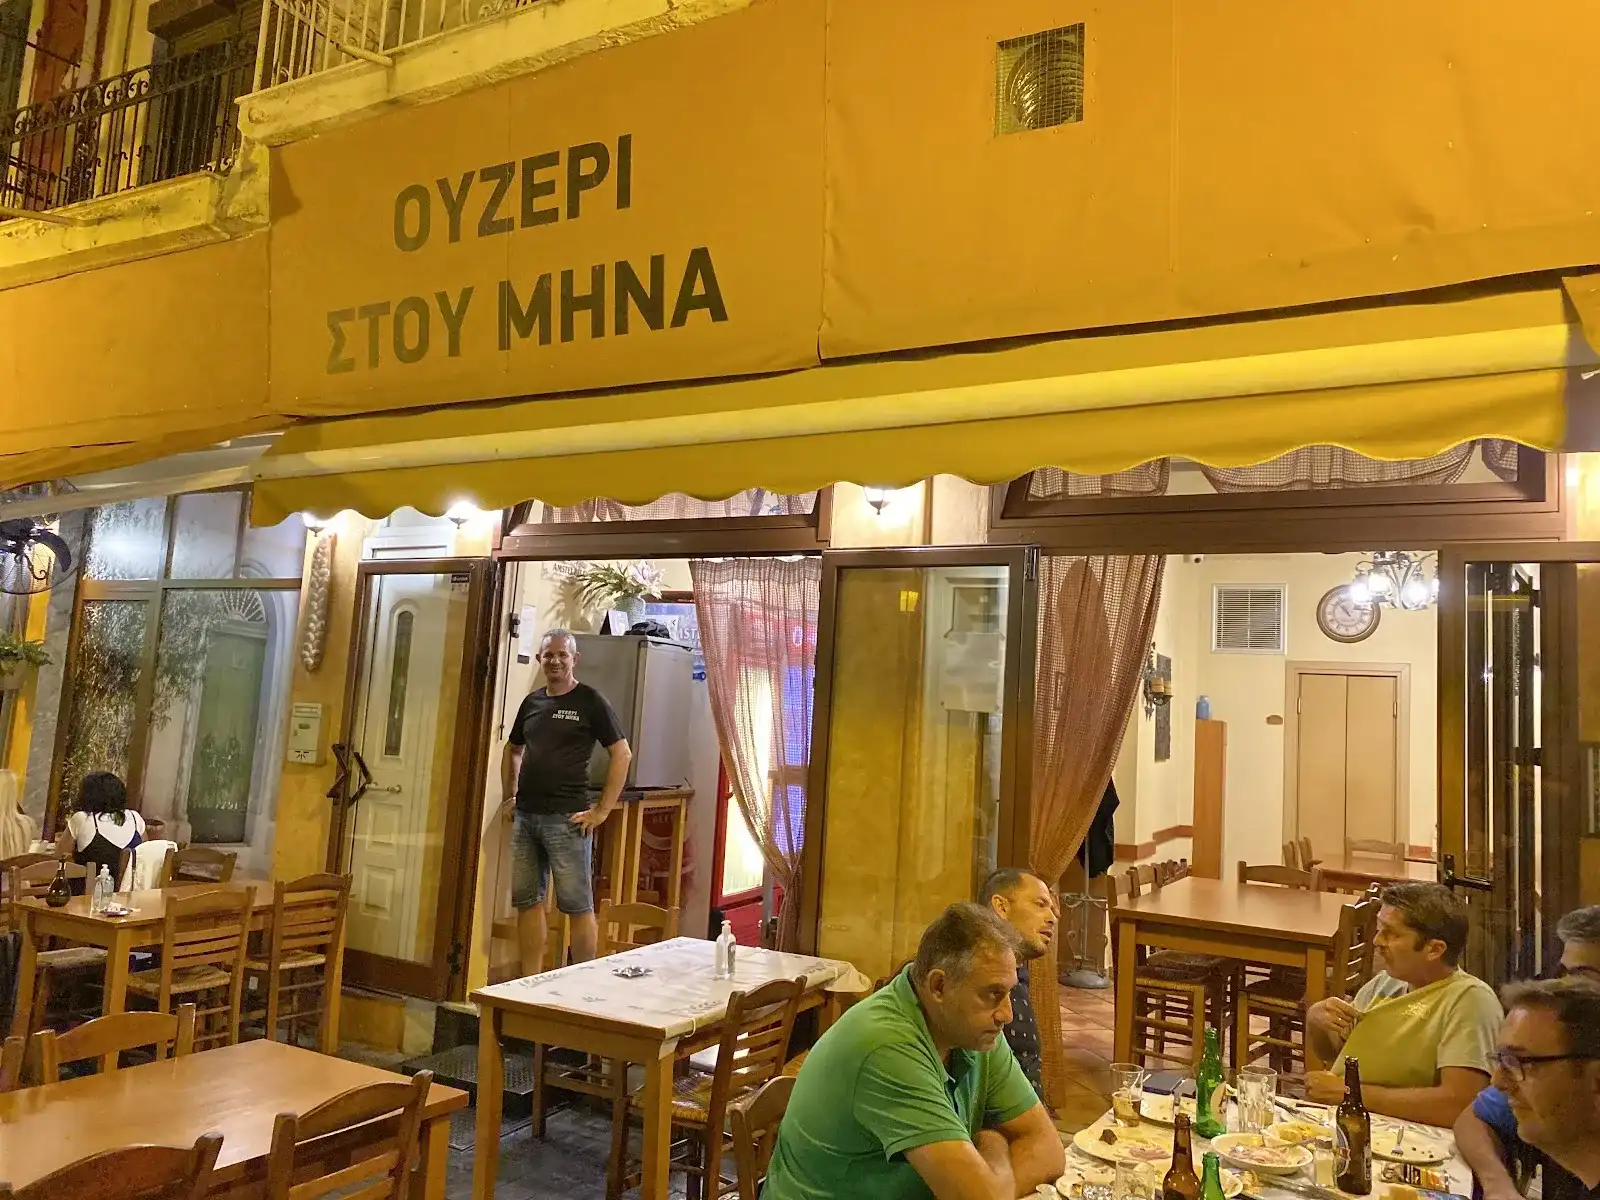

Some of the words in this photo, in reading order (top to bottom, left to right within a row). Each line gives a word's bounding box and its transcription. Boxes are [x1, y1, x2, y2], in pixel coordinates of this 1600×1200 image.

[393, 134, 632, 252] ΟΥΖΕΡΙ
[326, 286, 474, 374] ΣΤΟΥ
[498, 245, 729, 351] ΜΗΝΑ
